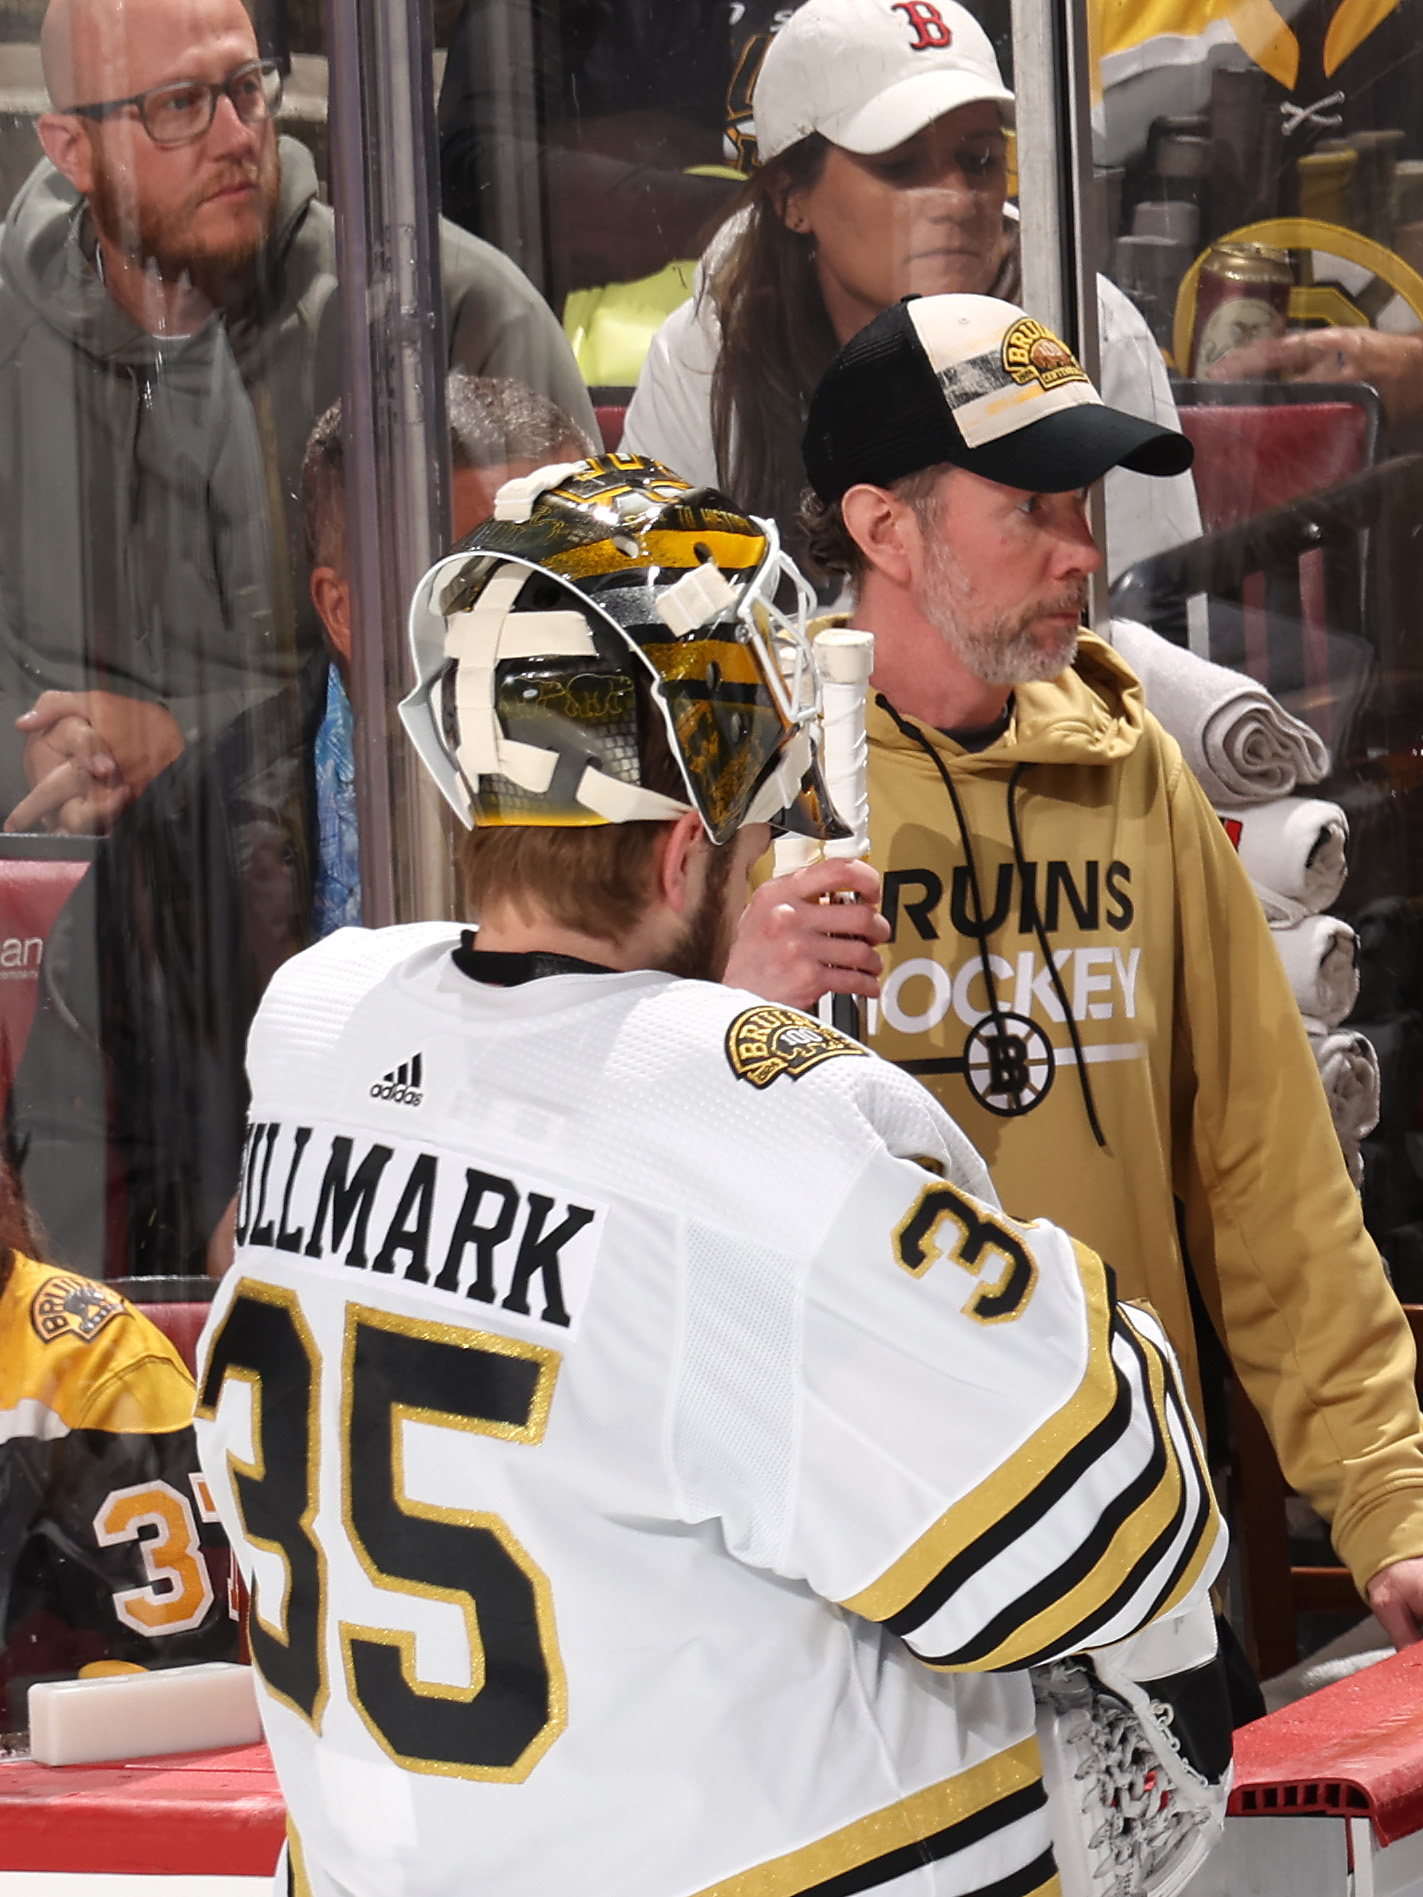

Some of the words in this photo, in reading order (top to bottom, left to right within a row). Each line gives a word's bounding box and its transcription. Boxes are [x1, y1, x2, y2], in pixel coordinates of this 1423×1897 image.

[891, 1, 952, 50] B
[880, 859, 1135, 944] RUINS
[370, 1082, 424, 1107] adidas
[236, 1120, 597, 1328] ULLMARK
[195, 1276, 569, 1785] 35
